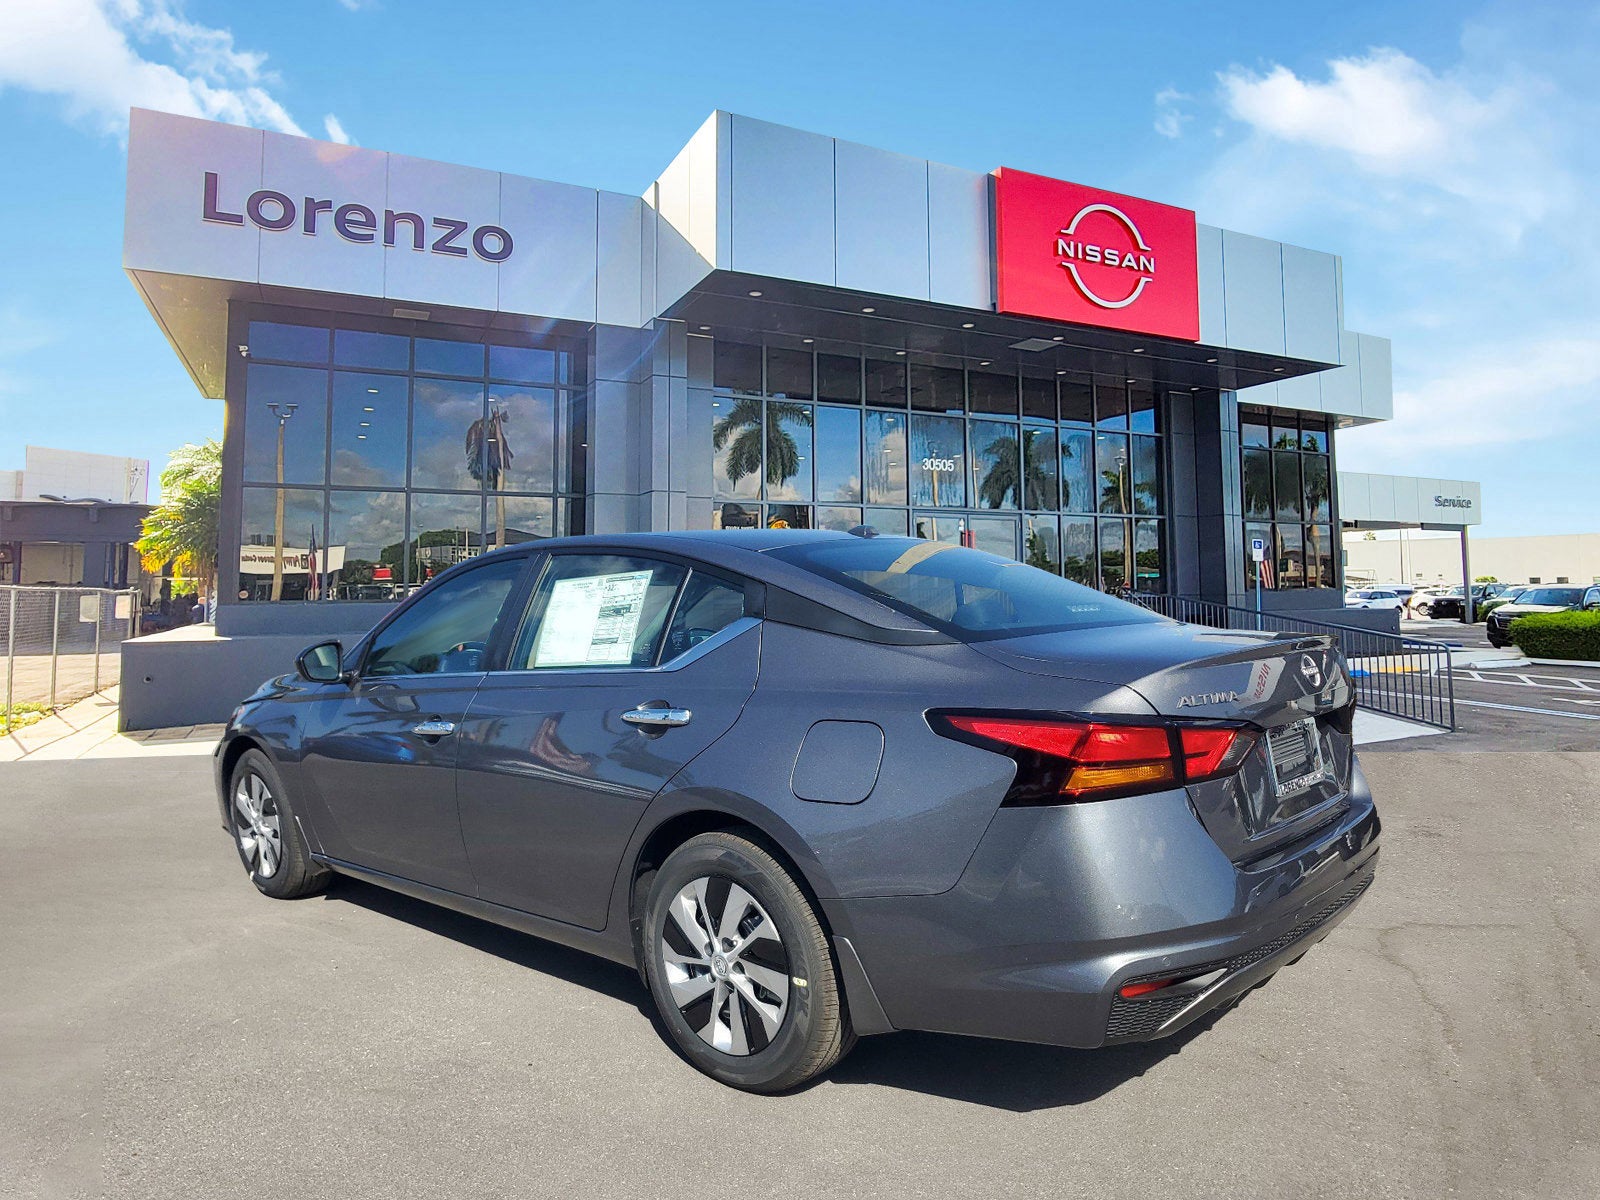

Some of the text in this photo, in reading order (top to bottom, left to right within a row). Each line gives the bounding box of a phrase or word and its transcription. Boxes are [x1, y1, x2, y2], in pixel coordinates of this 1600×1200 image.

[202, 170, 515, 263] Lorenzo
[1057, 238, 1155, 273] NISSAN
[922, 457, 955, 472] 30505
[1434, 495, 1473, 509] Service
[1176, 690, 1239, 709] ALTIMA
